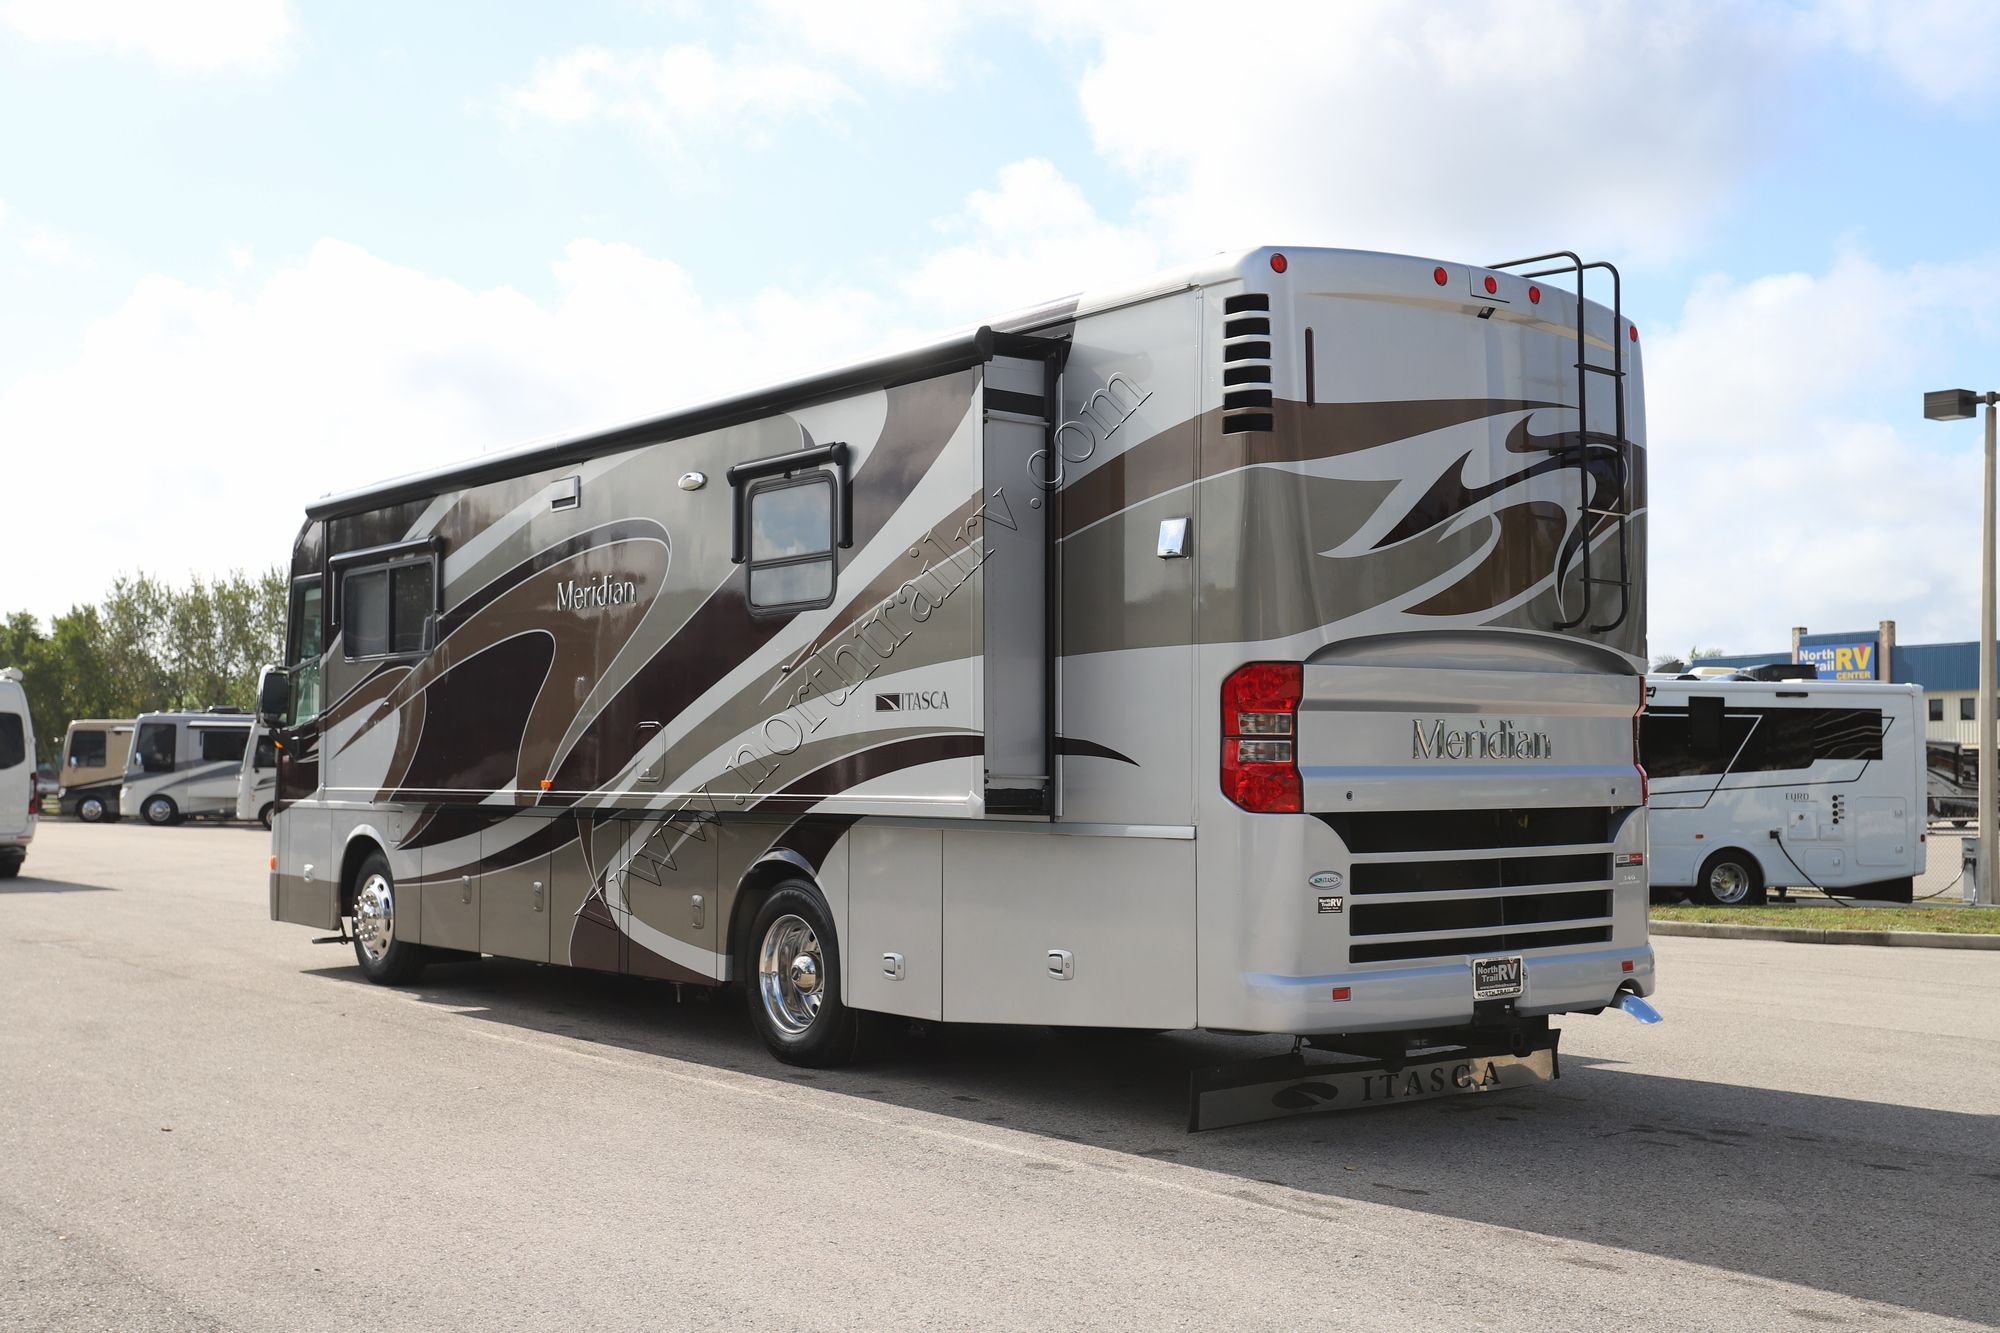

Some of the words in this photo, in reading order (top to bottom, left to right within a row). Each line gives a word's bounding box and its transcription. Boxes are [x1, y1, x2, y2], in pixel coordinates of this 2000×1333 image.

[557, 574, 637, 612] Meridian
[1799, 648, 1834, 661] North
[1836, 645, 1871, 671] RV
[1837, 671, 1871, 680] CENTER
[900, 690, 949, 711] ITASCA
[1412, 719, 1552, 759] Meridian
[1331, 898, 1342, 906] RV
[1477, 965, 1498, 975] North
[1481, 974, 1498, 983] Trail
[1498, 963, 1518, 981] RV
[1361, 1061, 1502, 1101] ITASCA
